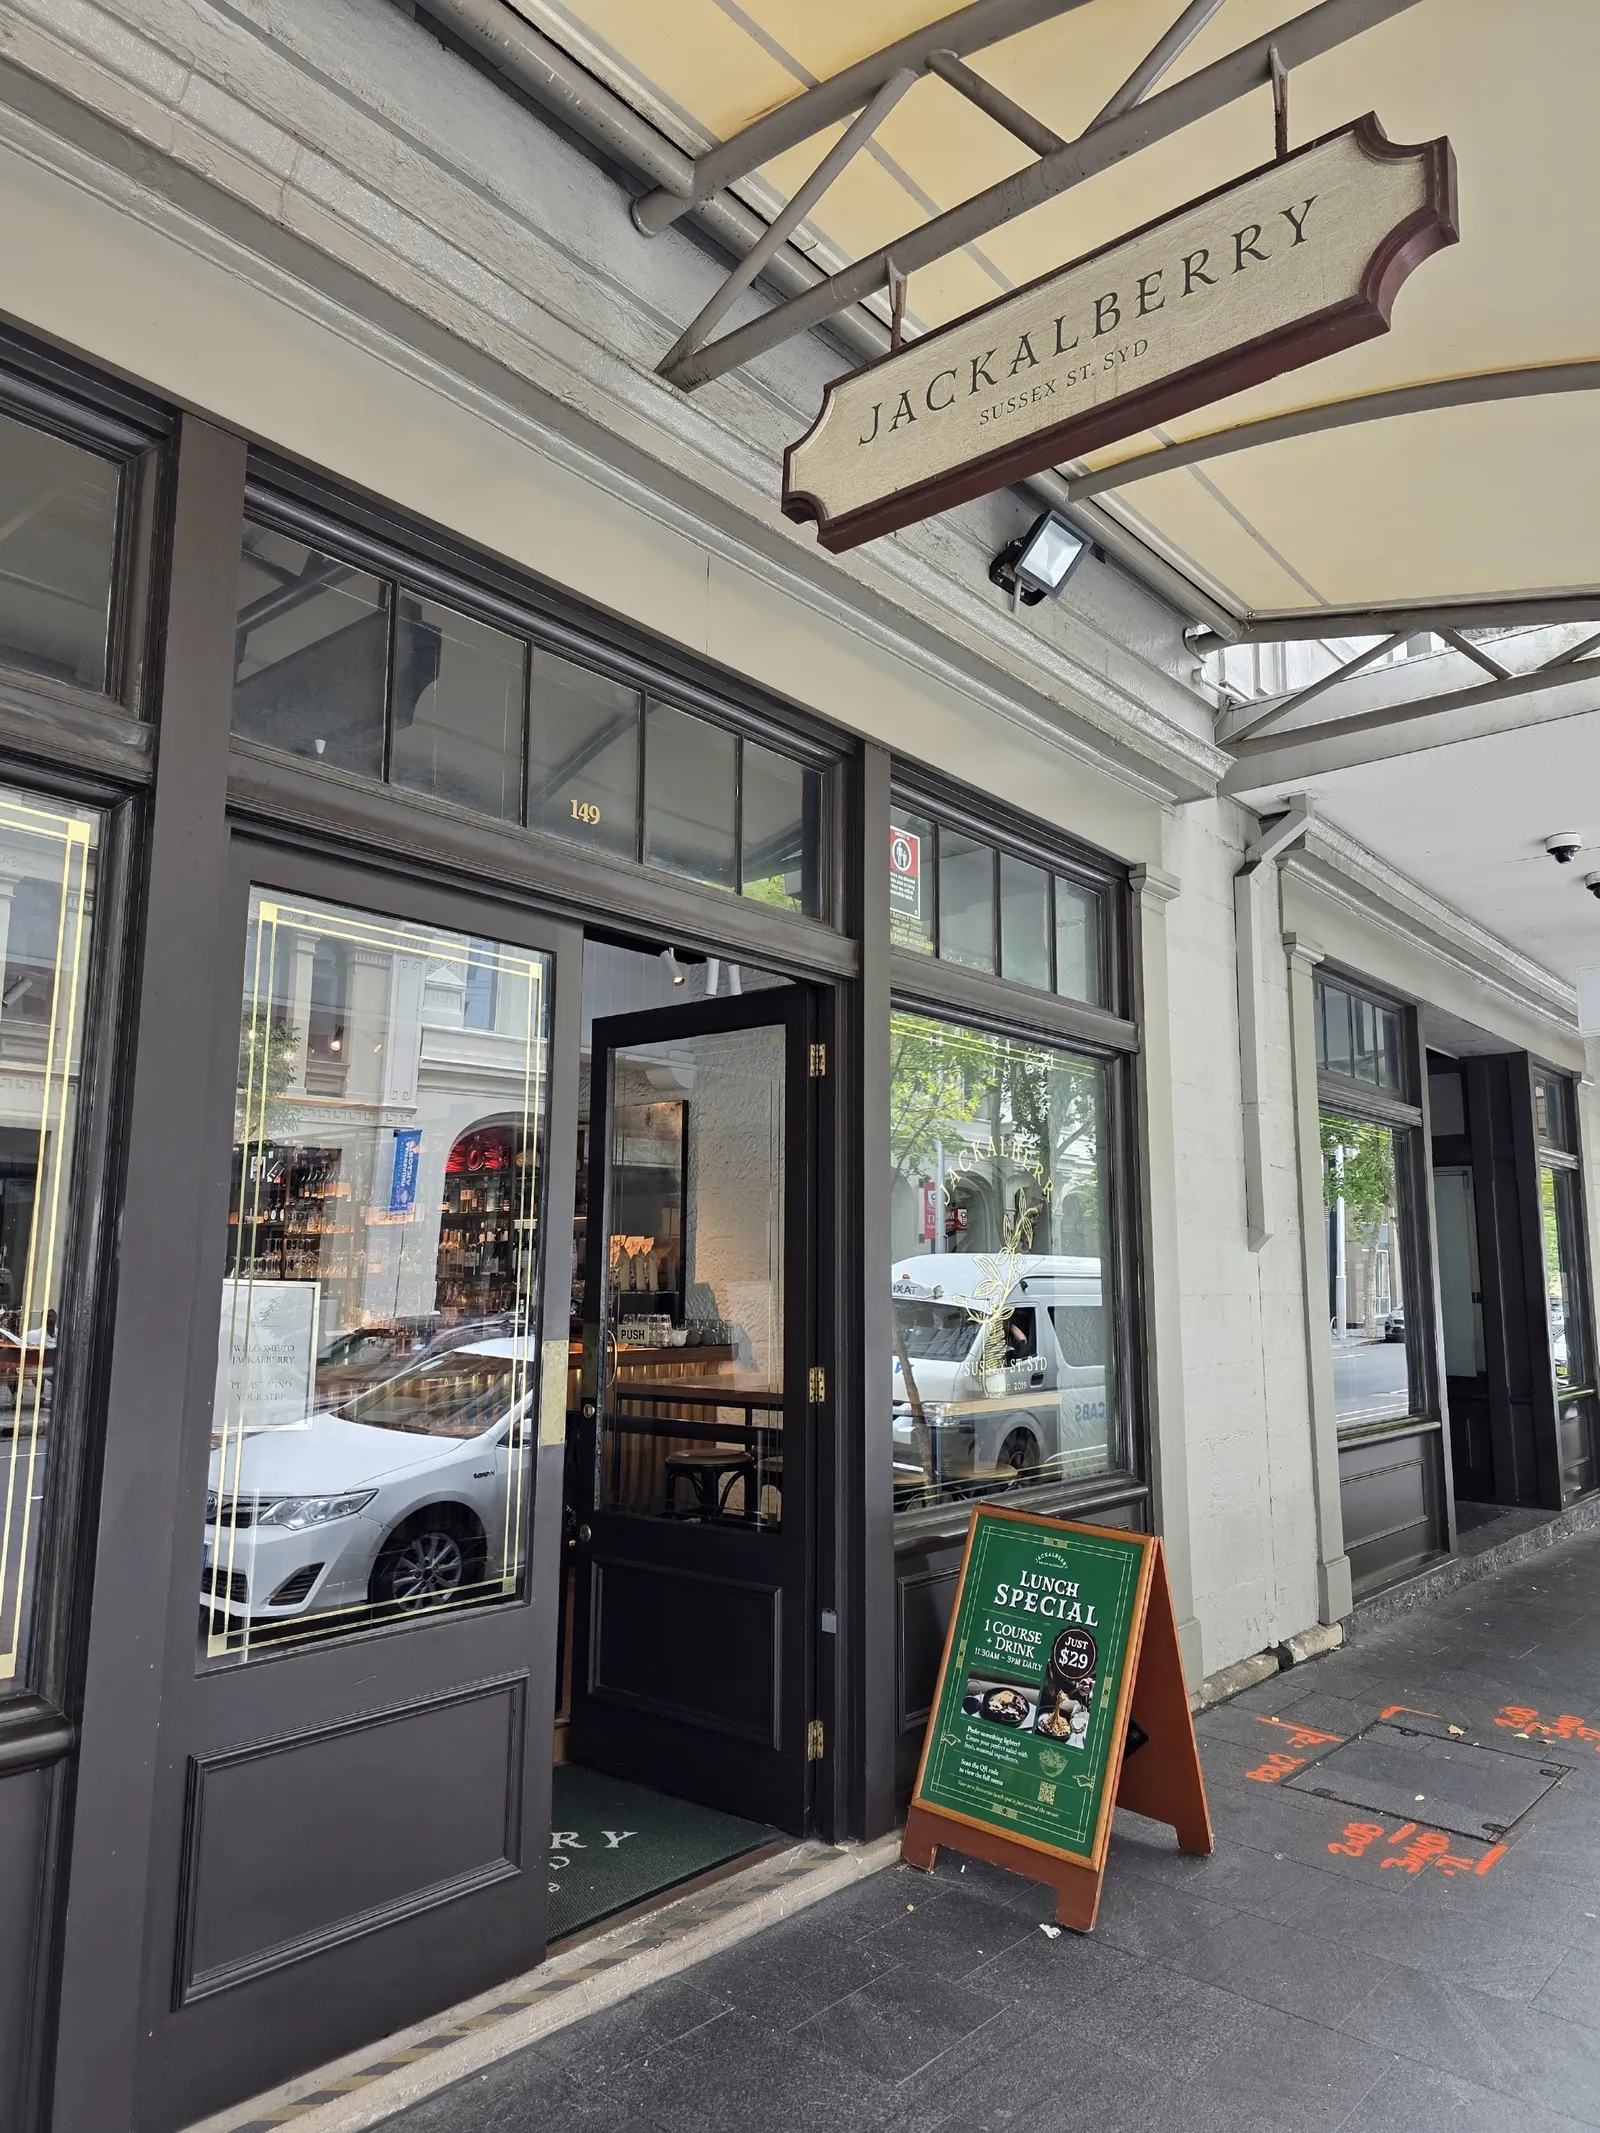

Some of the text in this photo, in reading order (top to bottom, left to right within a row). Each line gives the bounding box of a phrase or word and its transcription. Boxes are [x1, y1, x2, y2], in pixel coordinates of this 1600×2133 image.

[857, 195, 1322, 448] JACKALBERRY
[978, 337, 1150, 427] SUSSEX ST. SYD
[570, 799, 601, 825] 149
[621, 1329, 645, 1340] PUSH
[1027, 1355, 1048, 1372] SYD
[231, 1381, 264, 1390] PLASE
[1019, 1570, 1080, 1598] LUNCH
[993, 1583, 1099, 1627] SPECIAL
[984, 1619, 1043, 1645] 1 COURSE
[995, 1637, 1035, 1659] DRINK
[1065, 1637, 1089, 1650] JUST
[1007, 1655, 1021, 1666] 3PM
[1022, 1659, 1043, 1672] DAILY
[1059, 1647, 1088, 1669] $29
[965, 1734, 980, 1744] Create
[967, 1725, 981, 1735] Prefer
[981, 1730, 1003, 1743] something
[960, 1758, 971, 1767] Scan
[979, 1764, 988, 1773] QR
